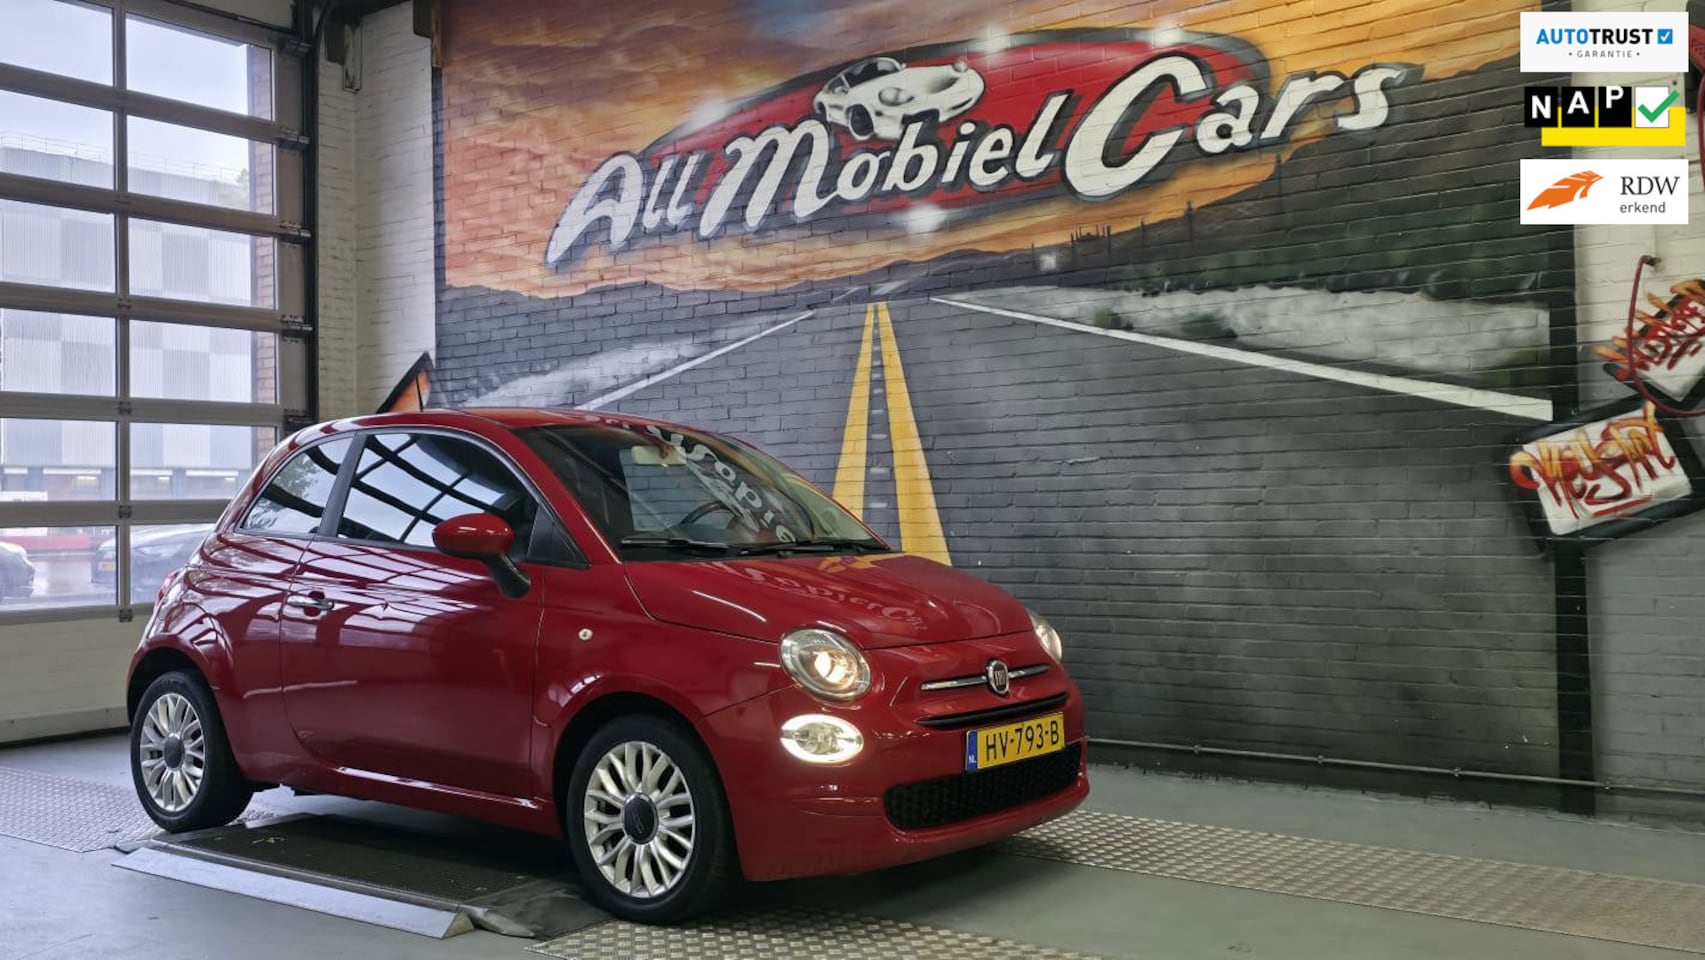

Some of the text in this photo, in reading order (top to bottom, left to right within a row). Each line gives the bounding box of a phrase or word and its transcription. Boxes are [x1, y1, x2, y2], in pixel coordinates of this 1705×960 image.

[546, 54, 1406, 264] All Mobiel Cars
[968, 755, 977, 764] NL
[985, 719, 1060, 762] HV-793-B
